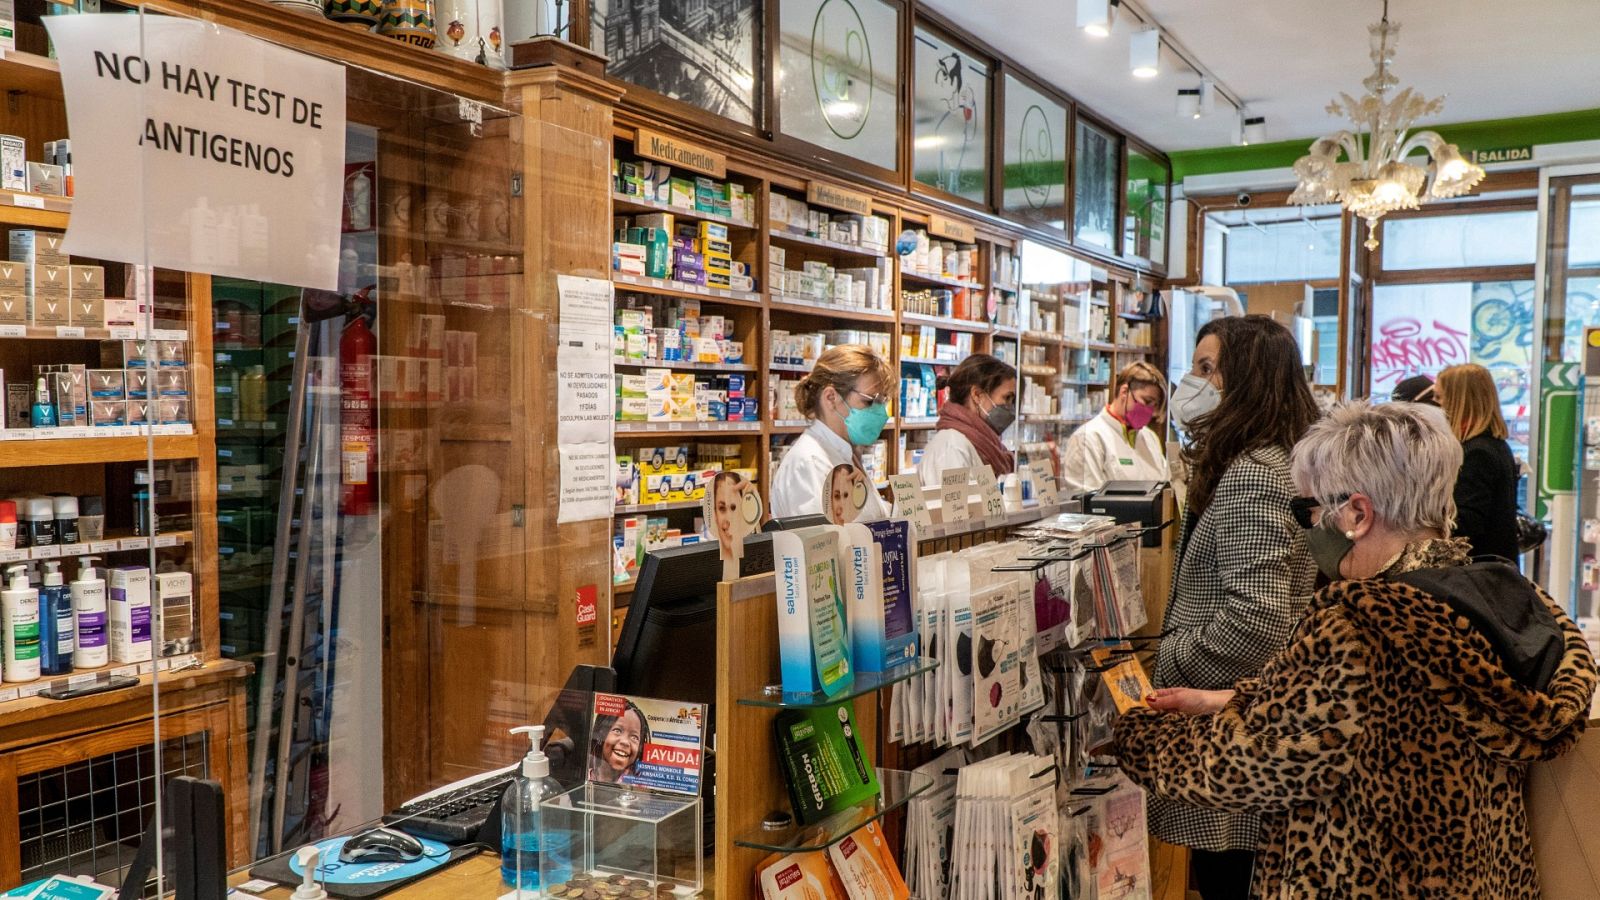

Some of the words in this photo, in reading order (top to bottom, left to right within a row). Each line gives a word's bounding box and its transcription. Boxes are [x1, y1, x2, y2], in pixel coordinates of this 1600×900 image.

[94, 50, 150, 84] NO
[162, 61, 220, 101] HAY
[227, 78, 286, 119] TEST
[292, 97, 323, 129] DE
[138, 118, 295, 178] ANTIGENOS
[651, 137, 715, 172] Medicamentos
[1479, 148, 1530, 162] SALIDA
[638, 763, 658, 771] HOSPITAL
[646, 748, 699, 766] ¡AYUDA!
